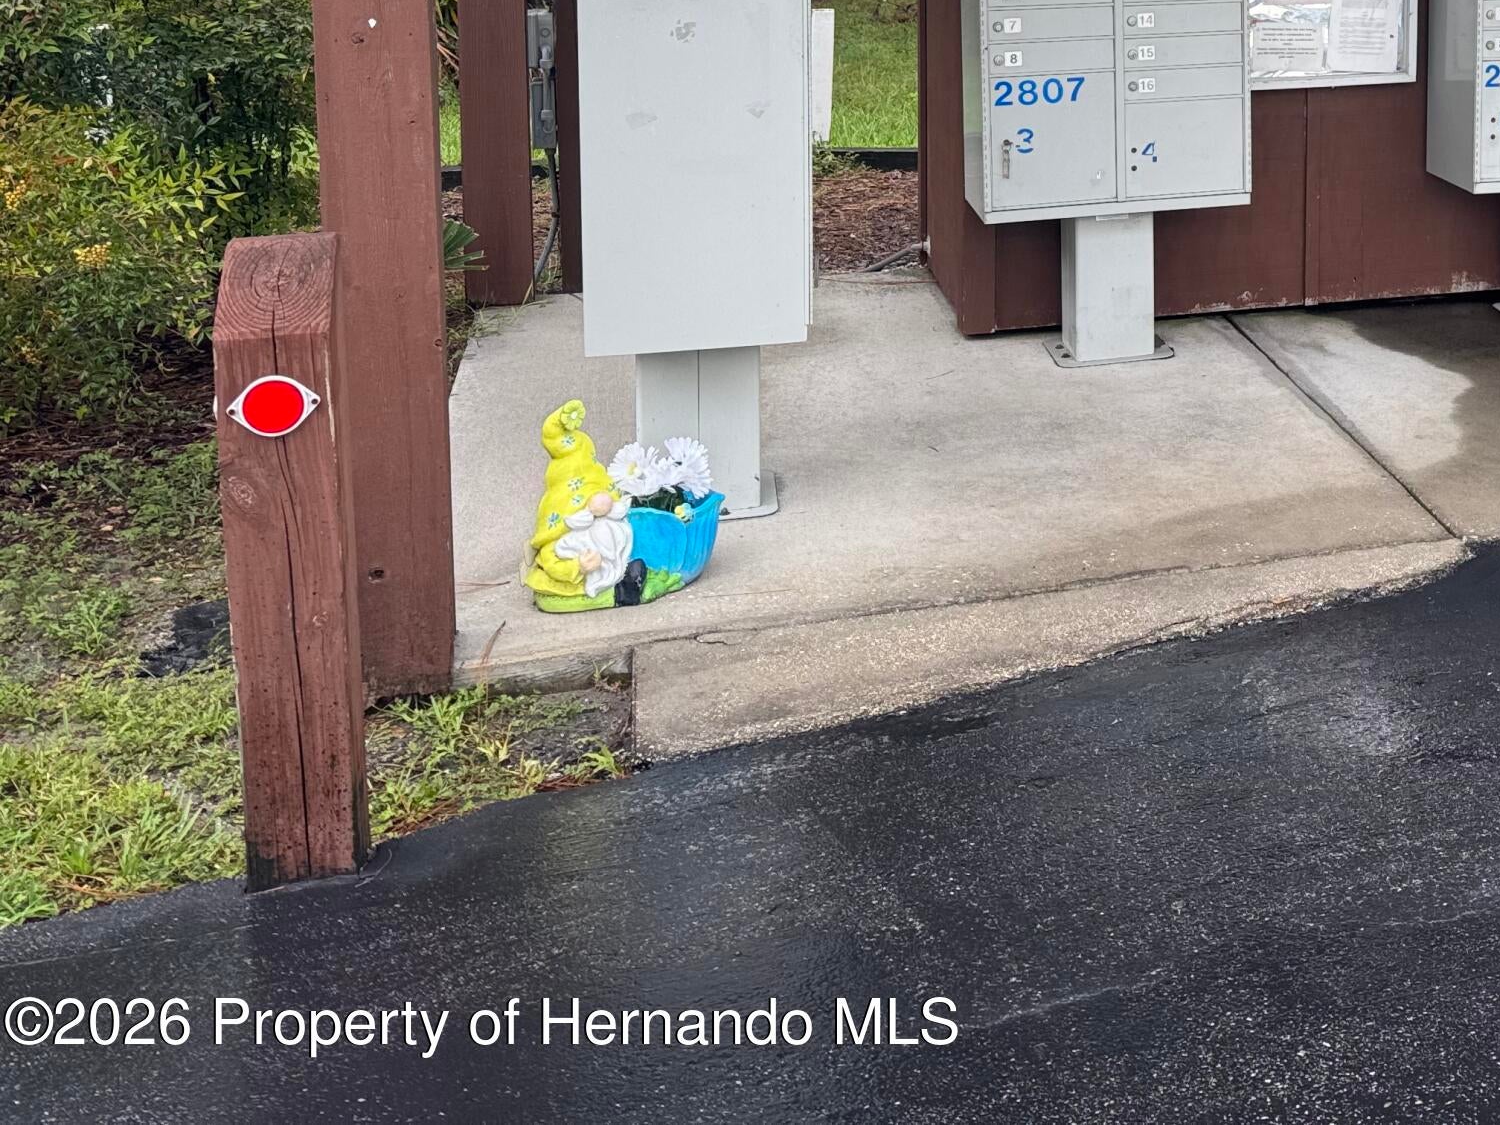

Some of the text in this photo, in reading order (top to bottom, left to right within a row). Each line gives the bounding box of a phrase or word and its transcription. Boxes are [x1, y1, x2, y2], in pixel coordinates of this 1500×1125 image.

[1008, 20, 1017, 31] 7
[1138, 15, 1154, 26] 14
[1009, 53, 1018, 64] 8
[1139, 47, 1154, 59] 15
[993, 76, 1086, 107] 2807
[1139, 80, 1155, 92] 16
[1015, 127, 1035, 154] 3
